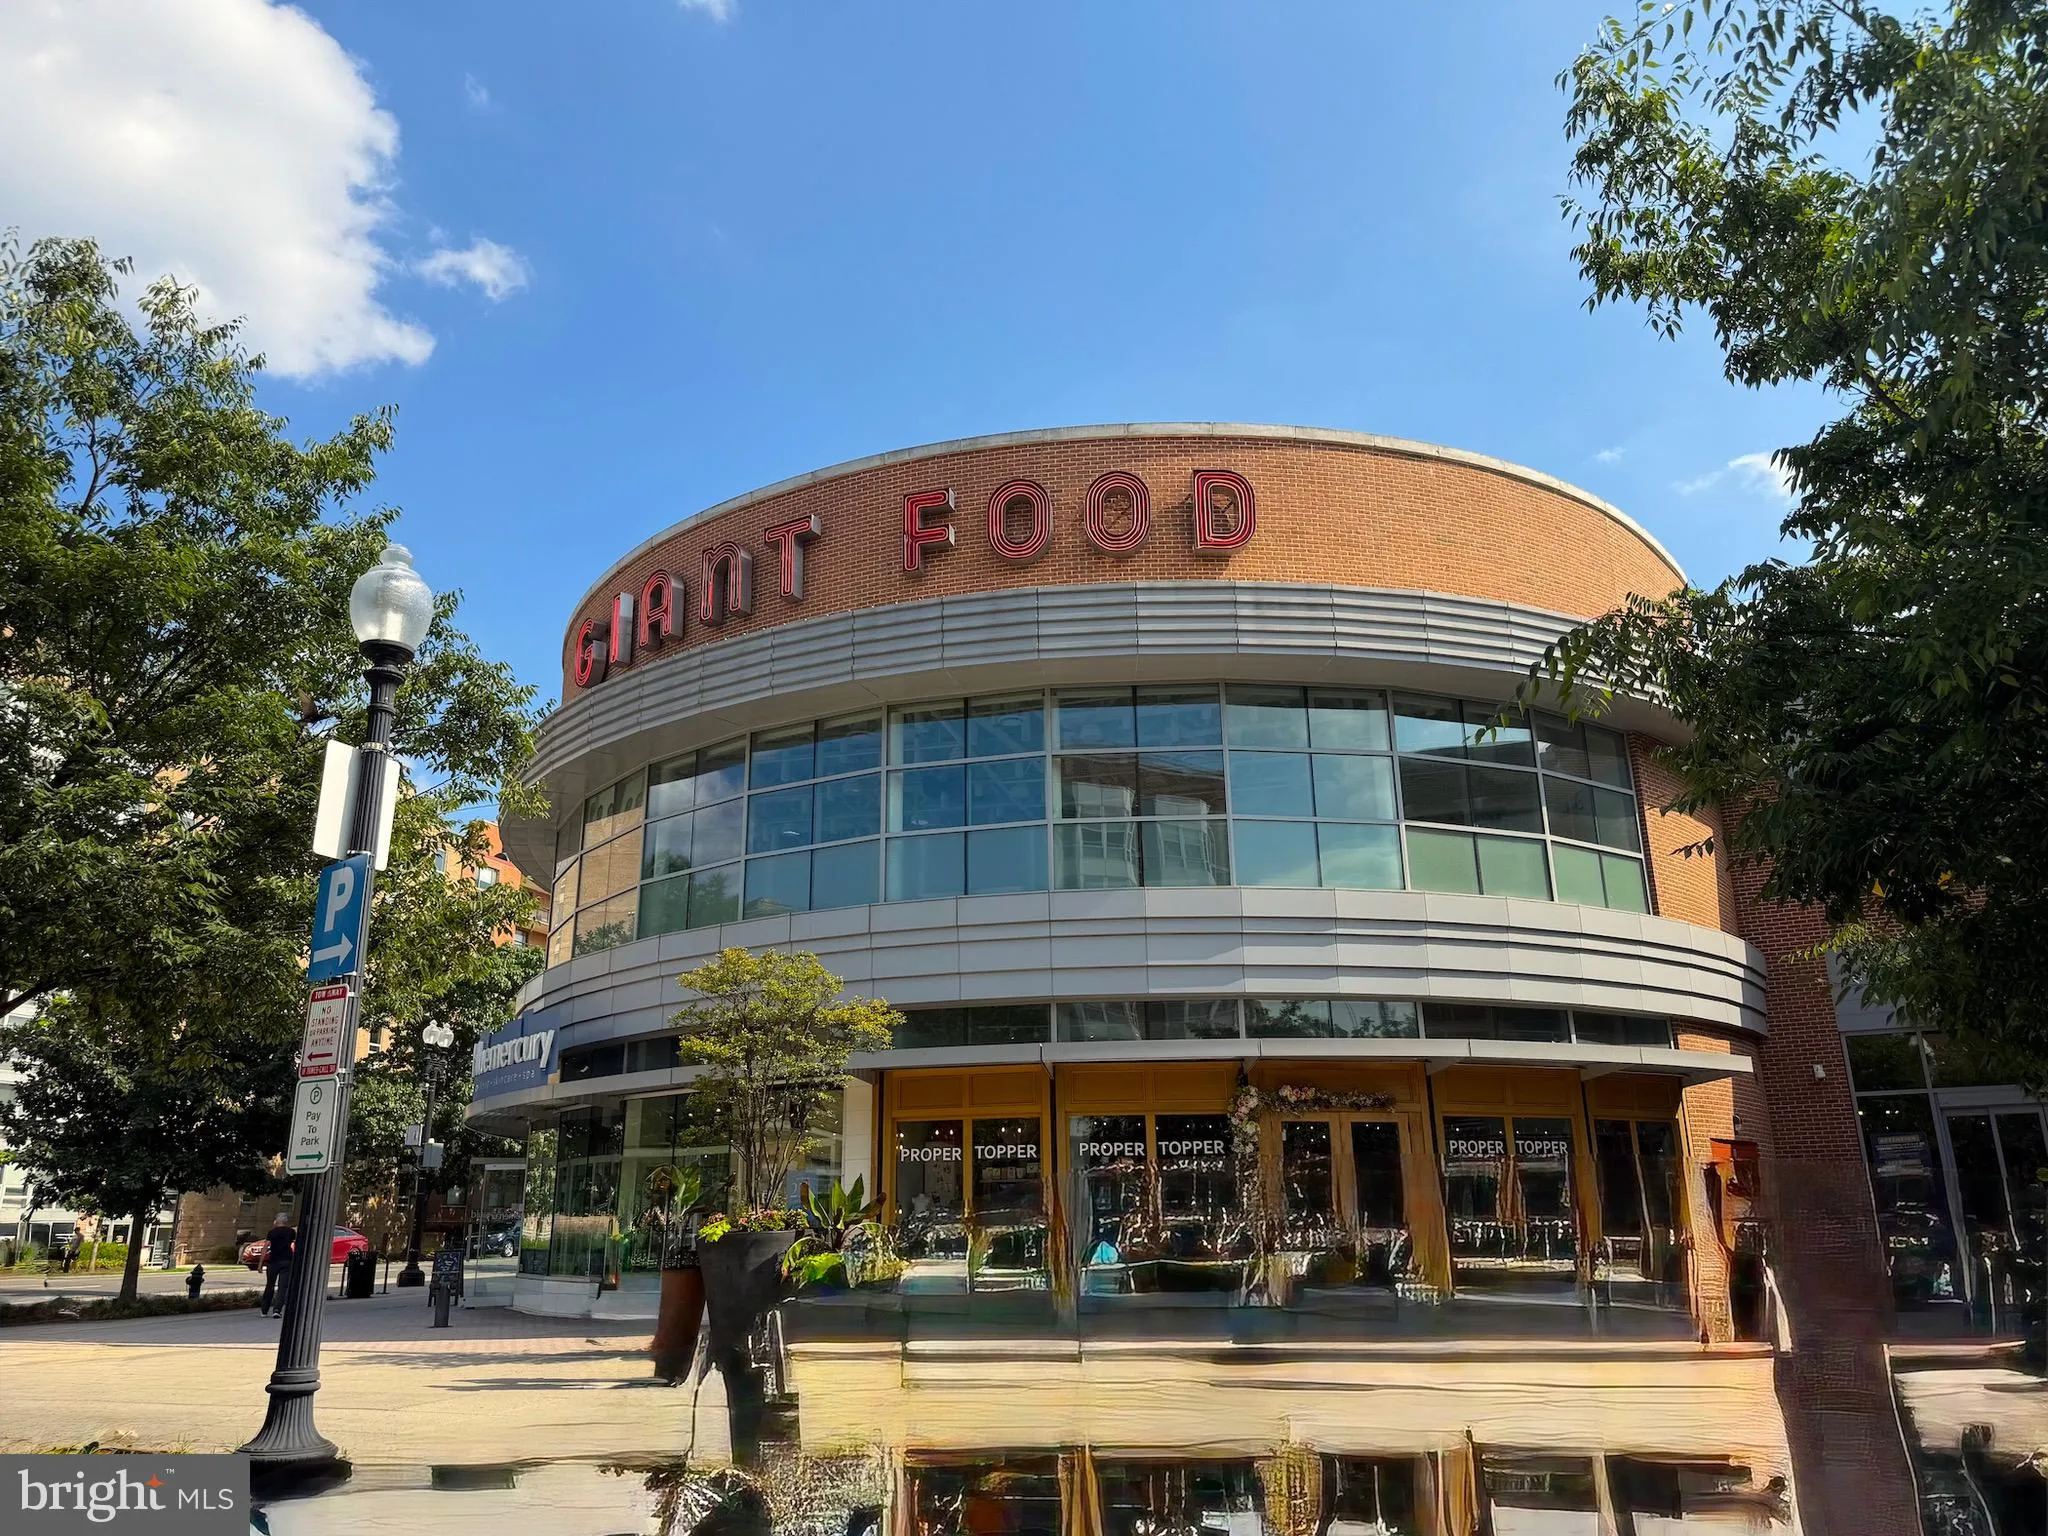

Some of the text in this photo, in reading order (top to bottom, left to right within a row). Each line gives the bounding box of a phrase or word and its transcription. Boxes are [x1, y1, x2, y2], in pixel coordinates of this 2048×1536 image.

[574, 469, 1257, 690] GIANT FOOD
[324, 866, 355, 933] P
[322, 1006, 332, 1014] NO
[311, 1016, 339, 1027] STANDING
[311, 1037, 333, 1047] ANYTIME
[306, 1111, 321, 1122] Pay
[307, 1125, 317, 1134] To
[300, 1137, 320, 1146] Park
[1449, 1139, 1568, 1155] PROPER TOPPER
[900, 1144, 1038, 1162] PROPER TOPPER
[1079, 1140, 1226, 1157] PROPER TOPPER
